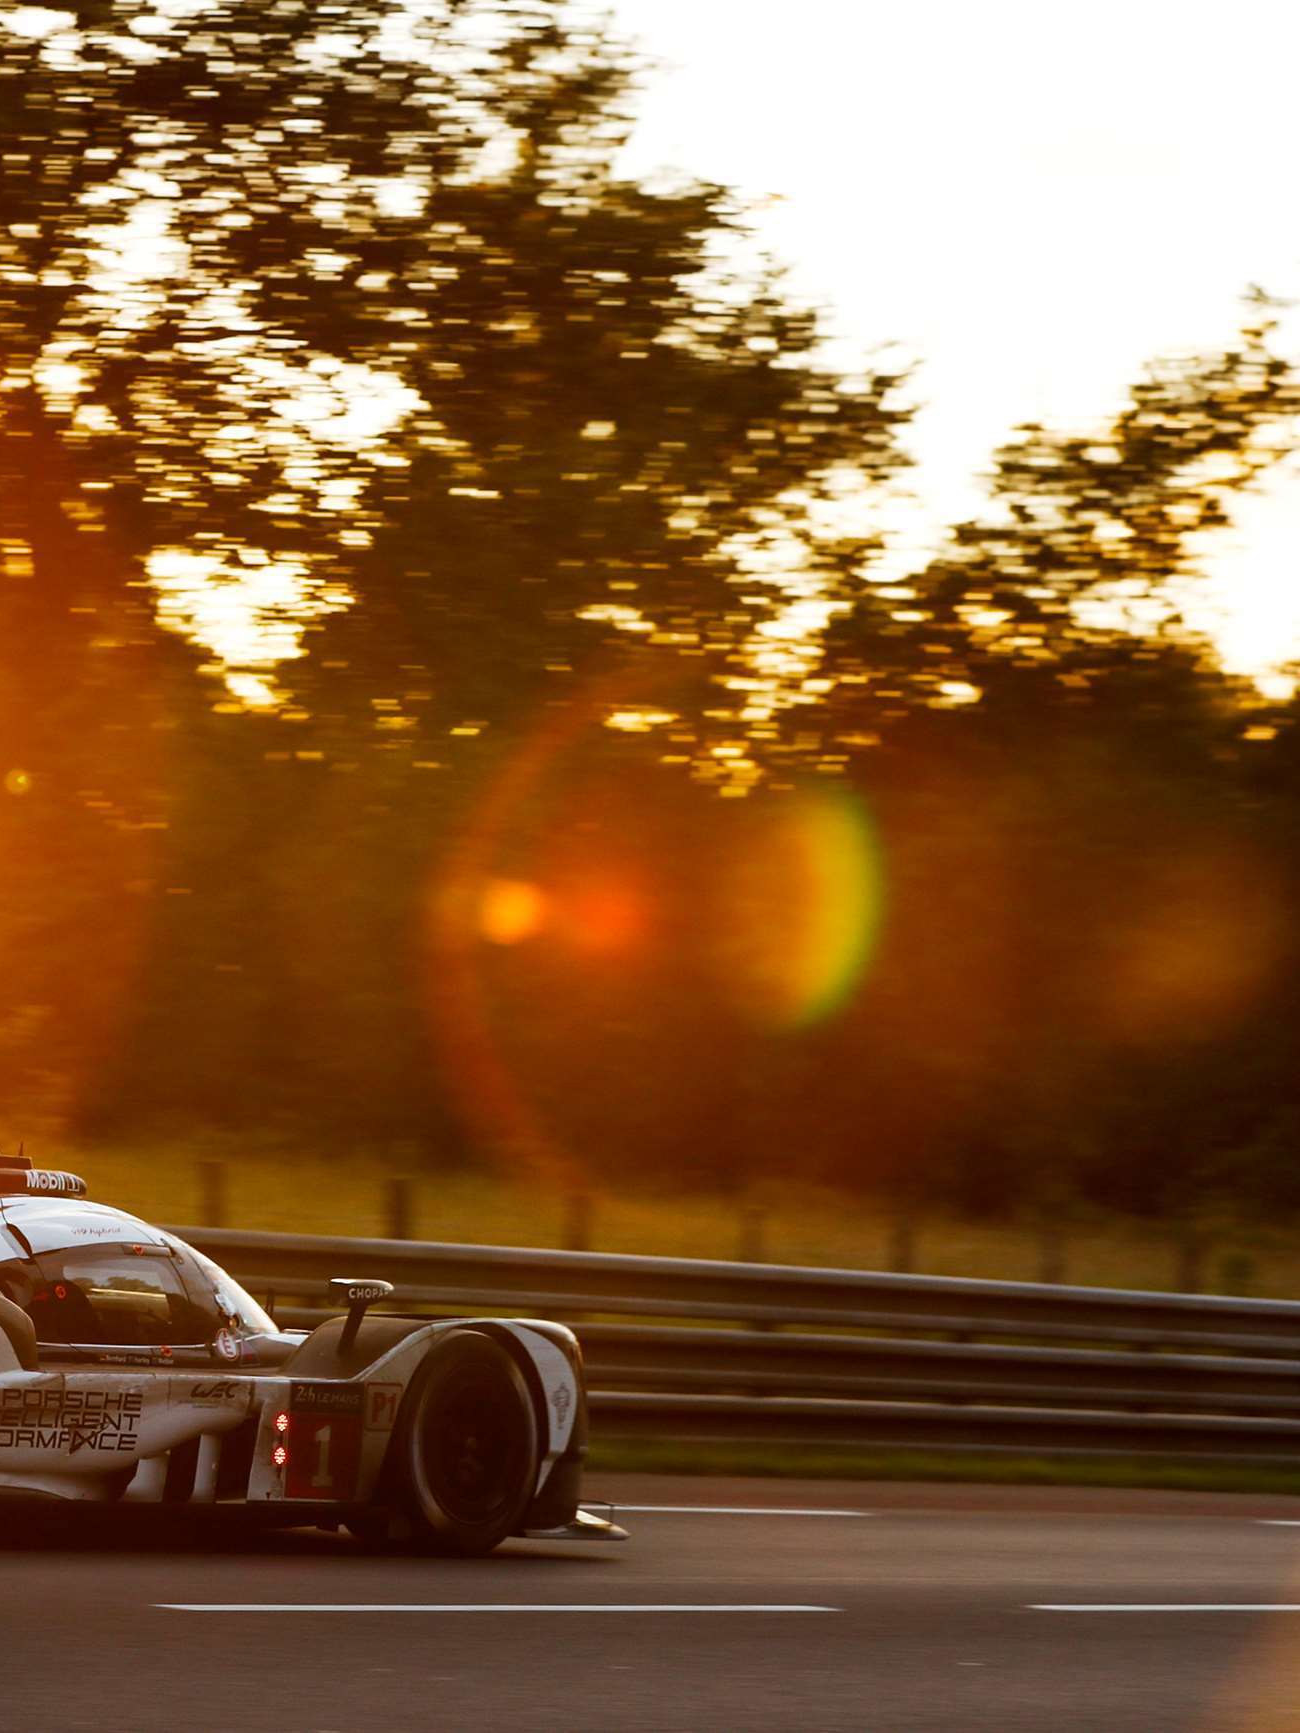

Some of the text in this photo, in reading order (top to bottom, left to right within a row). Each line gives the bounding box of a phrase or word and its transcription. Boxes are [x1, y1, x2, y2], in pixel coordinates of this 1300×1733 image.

[27, 1171, 65, 1190] Mobil
[2, 1388, 143, 1412] PORSCHE
[190, 1382, 239, 1398] WEC
[371, 1391, 397, 1424] P1
[311, 1424, 333, 1488] 1
